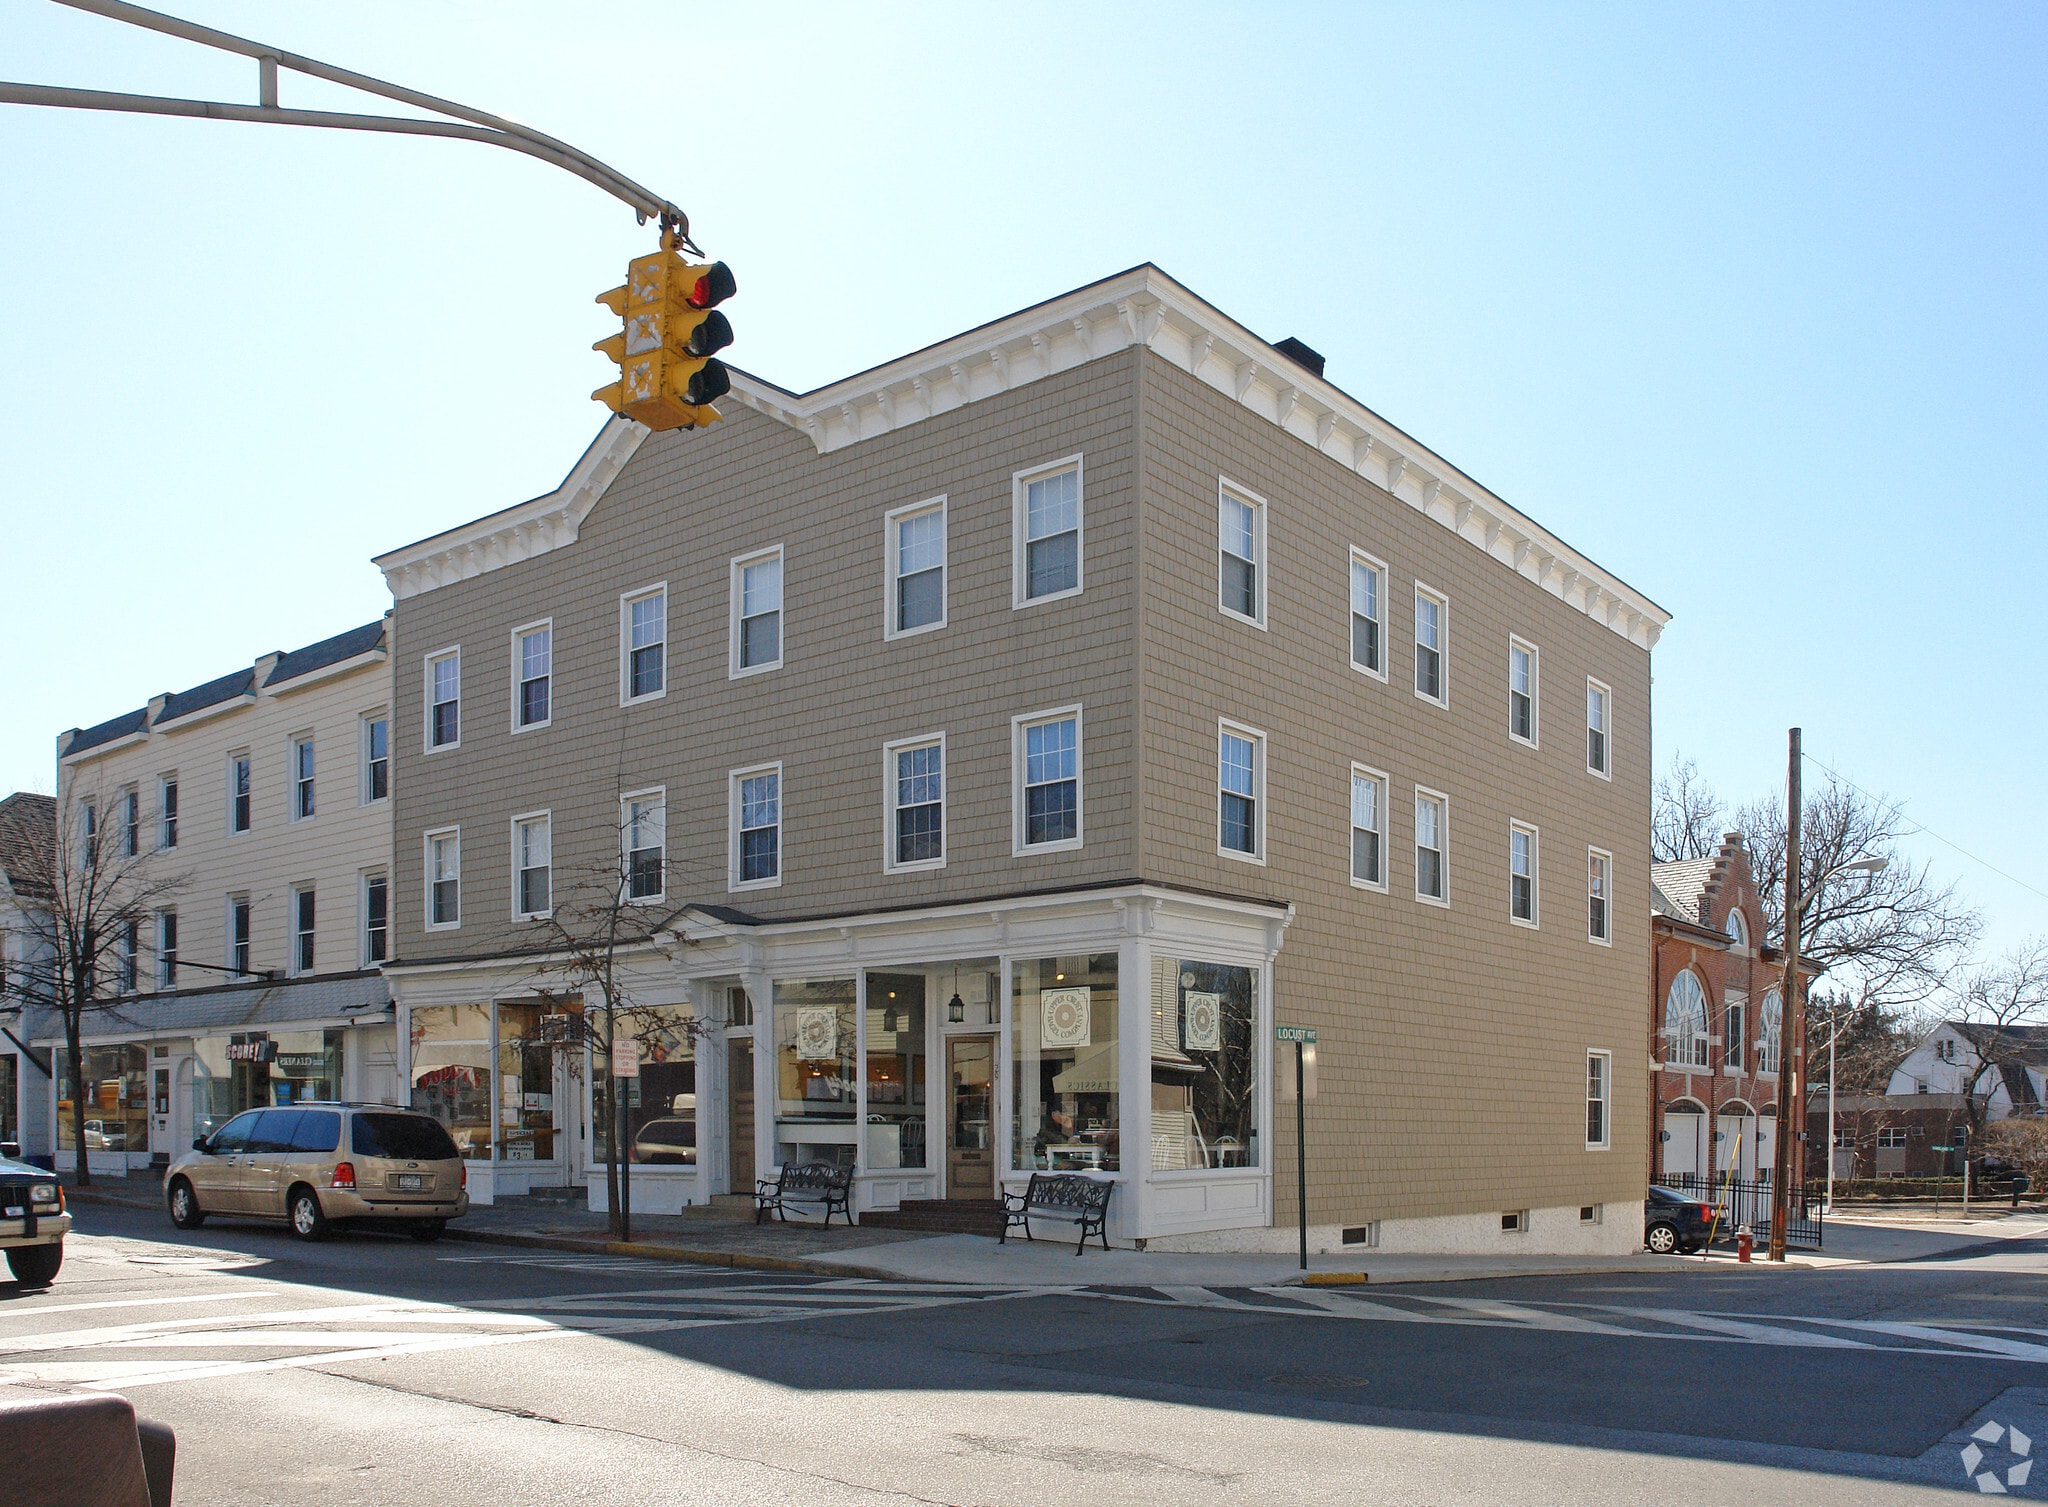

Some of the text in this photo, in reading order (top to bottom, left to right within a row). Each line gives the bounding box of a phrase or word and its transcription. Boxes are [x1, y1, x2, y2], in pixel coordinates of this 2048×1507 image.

[1048, 994, 1083, 1014] UPPER CRUST
[1278, 1028, 1316, 1040] LOCUST AVE
